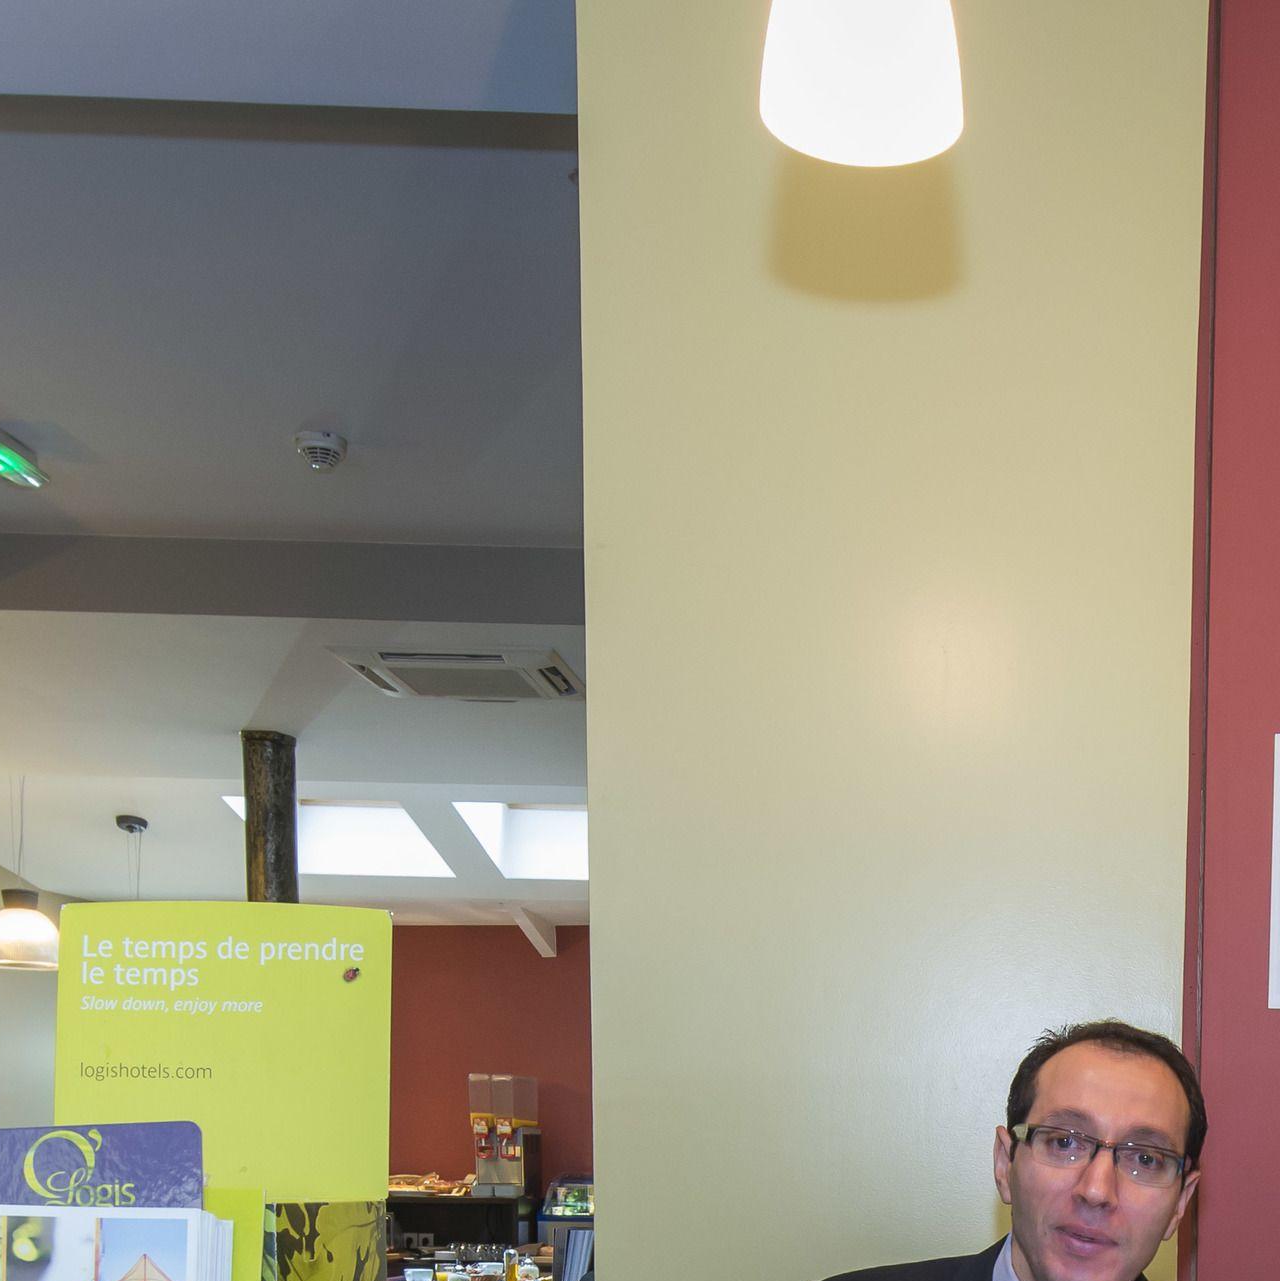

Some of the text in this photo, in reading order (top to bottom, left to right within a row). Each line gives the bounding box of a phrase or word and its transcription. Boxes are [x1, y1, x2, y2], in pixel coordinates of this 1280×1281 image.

[81, 935, 365, 966] Le temps de prendre
[81, 961, 200, 991] le temps
[80, 995, 264, 1015] Slow down, enjoy more
[80, 1062, 213, 1082] logishotels.com
